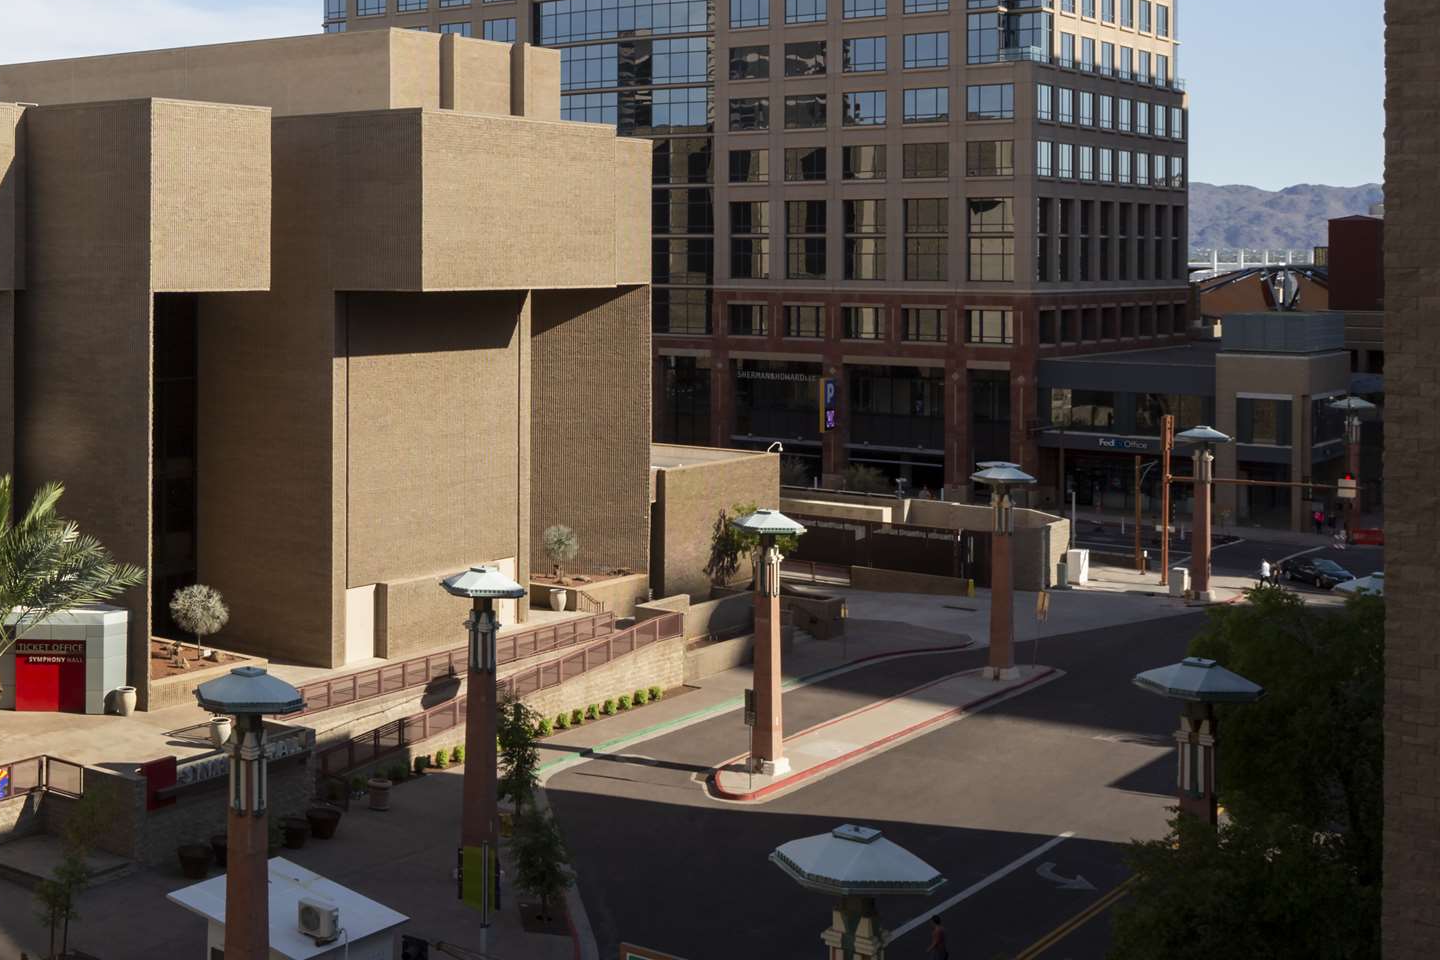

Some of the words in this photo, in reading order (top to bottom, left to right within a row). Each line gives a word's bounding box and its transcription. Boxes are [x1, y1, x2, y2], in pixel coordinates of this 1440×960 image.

[826, 383, 835, 404] P
[1124, 439, 1149, 448] Office
[16, 643, 50, 651] TICKET
[52, 644, 84, 652] OFFICE
